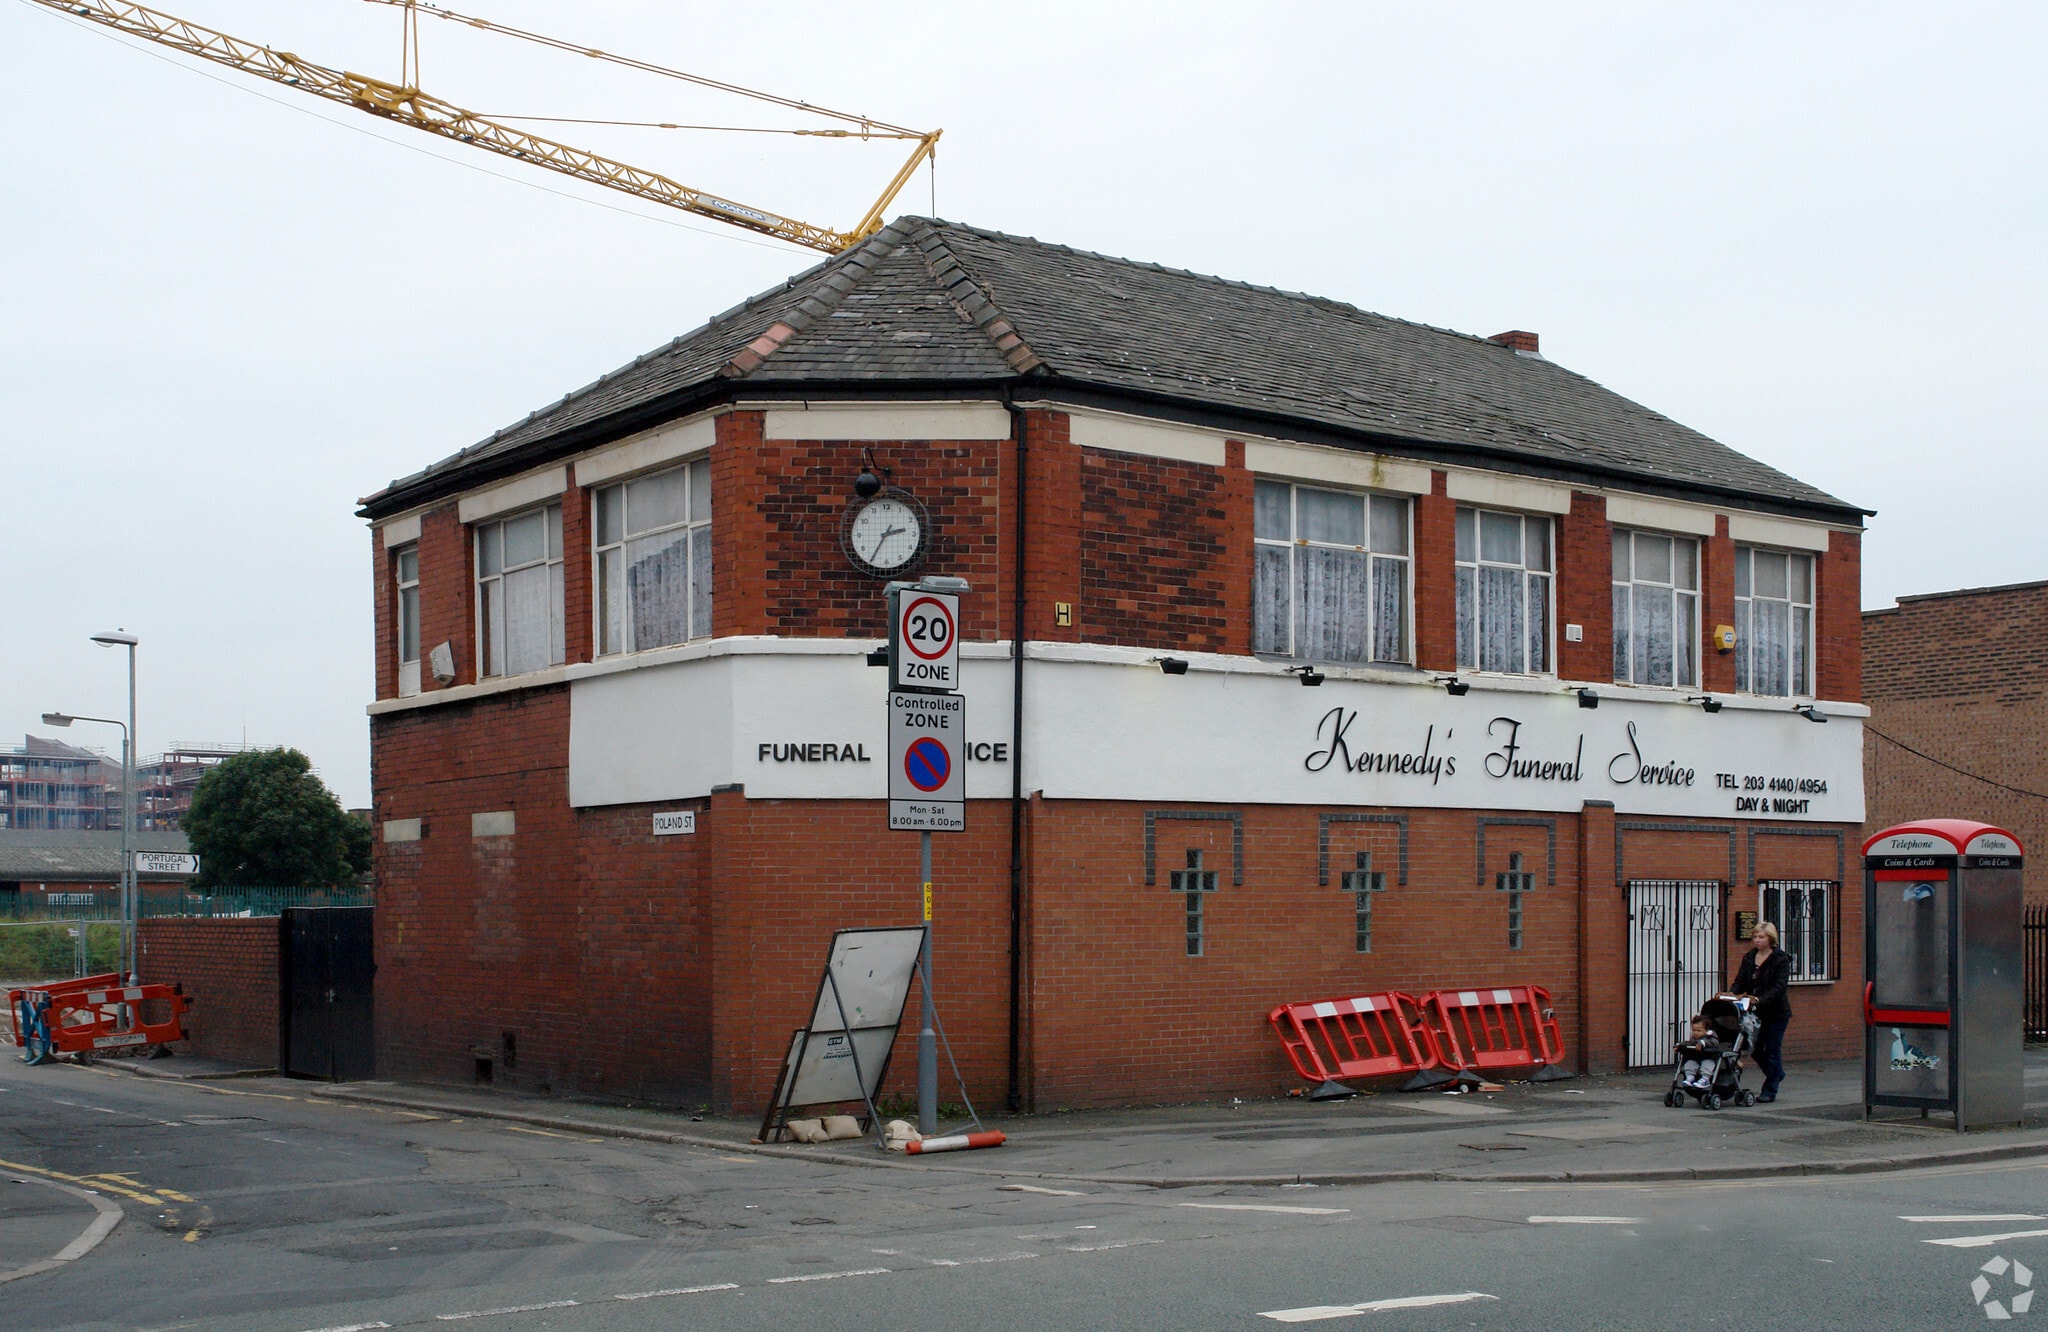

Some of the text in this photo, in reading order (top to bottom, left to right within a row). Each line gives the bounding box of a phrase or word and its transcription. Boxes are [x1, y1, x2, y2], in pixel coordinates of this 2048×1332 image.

[1057, 604, 1069, 624] H
[911, 615, 947, 642] 20
[906, 662, 950, 681] ZONE
[895, 696, 959, 711] Controlled
[905, 713, 949, 729] ZONE
[758, 743, 871, 763] FUNERAL
[1304, 706, 1696, 787] Kennedy's Funeral Service
[1715, 773, 1828, 794] TEL 203 4140/4954
[1736, 796, 1810, 813] DAY & NIGHT
[655, 817, 682, 829] POLAND
[1890, 839, 1934, 850] Telephone
[1980, 838, 2007, 850] Telephone
[142, 853, 188, 863] PORTUGAL
[1884, 857, 1935, 867] Coins & Cards
[148, 862, 181, 871] STREET
